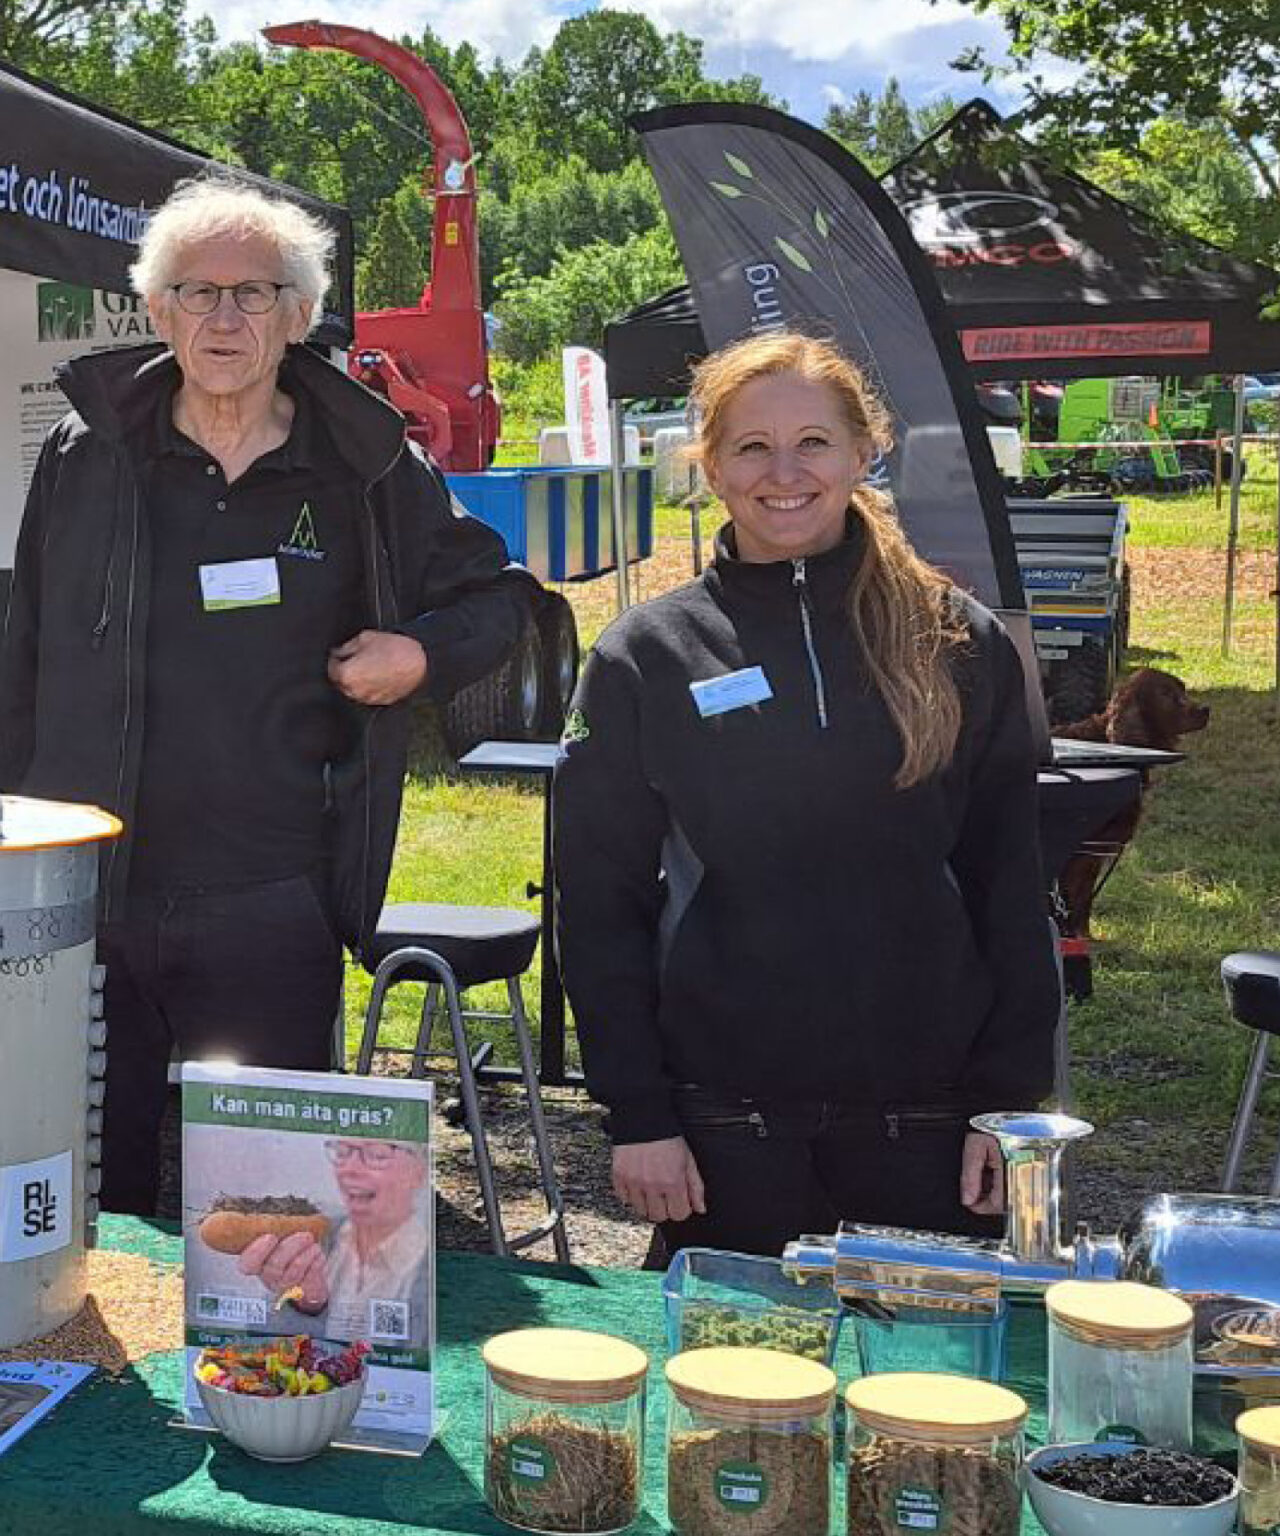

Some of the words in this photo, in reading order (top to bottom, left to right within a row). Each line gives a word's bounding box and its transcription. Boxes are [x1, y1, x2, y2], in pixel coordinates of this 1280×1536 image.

[23, 170, 63, 224] och
[212, 1094, 247, 1114] Kan
[255, 1100, 296, 1118] man
[302, 1100, 332, 1122] äta
[338, 1106, 394, 1128] gräs?
